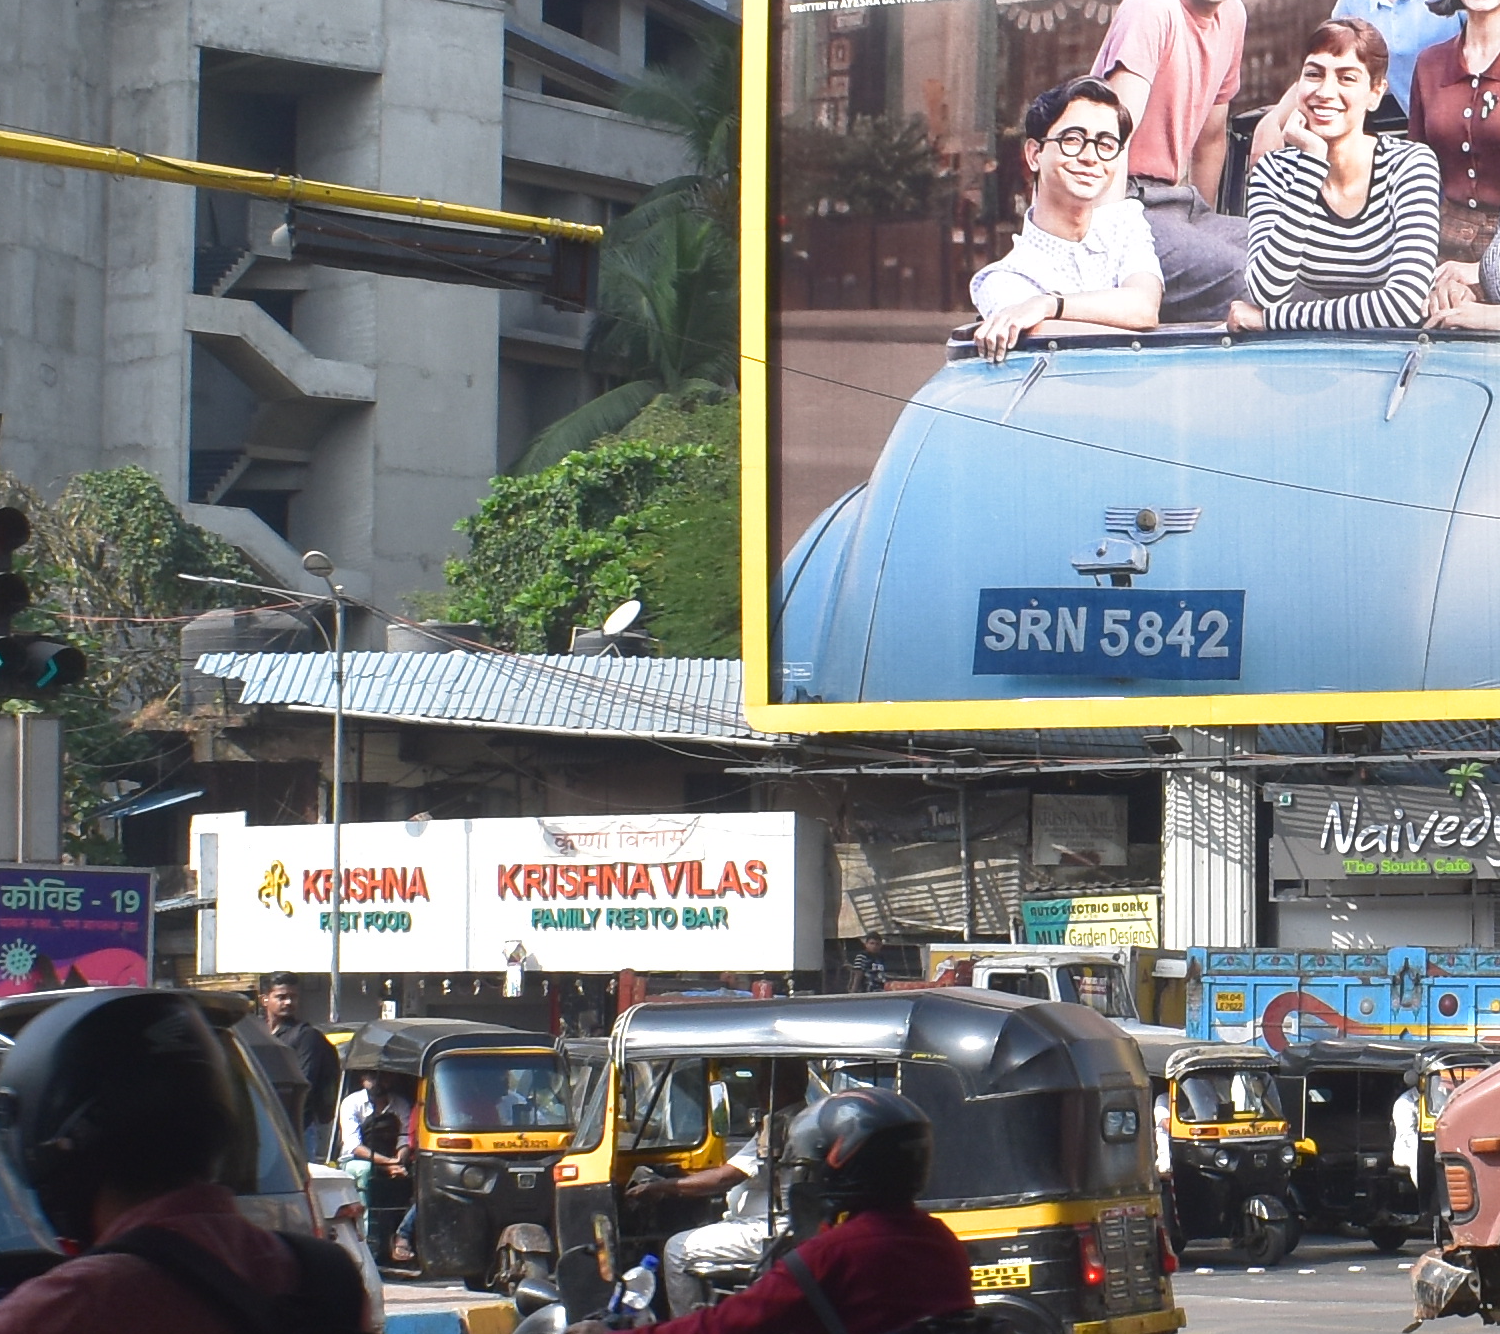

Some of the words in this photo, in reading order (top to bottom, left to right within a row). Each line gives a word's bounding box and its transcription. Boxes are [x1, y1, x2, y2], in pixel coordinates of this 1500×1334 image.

[984, 607, 1087, 653] SRN
[1099, 609, 1231, 658] 5842
[1343, 859, 1374, 874] The
[1380, 858, 1428, 874] South
[1433, 857, 1472, 874] Cafe
[303, 867, 430, 904] KRISHNA
[498, 862, 657, 900] KRISHNA
[660, 860, 768, 899] VILAS
[0, 878, 84, 910] कोविड
[111, 889, 140, 913] 19
[532, 908, 601, 931] FAMILY
[606, 907, 678, 930] RESTO
[682, 906, 729, 930] BAR
[1030, 905, 1061, 916] AUTO
[1112, 901, 1149, 913] WORKS
[364, 911, 412, 932] FOOD
[1069, 928, 1107, 946] Garden
[1110, 926, 1151, 946] Designs
